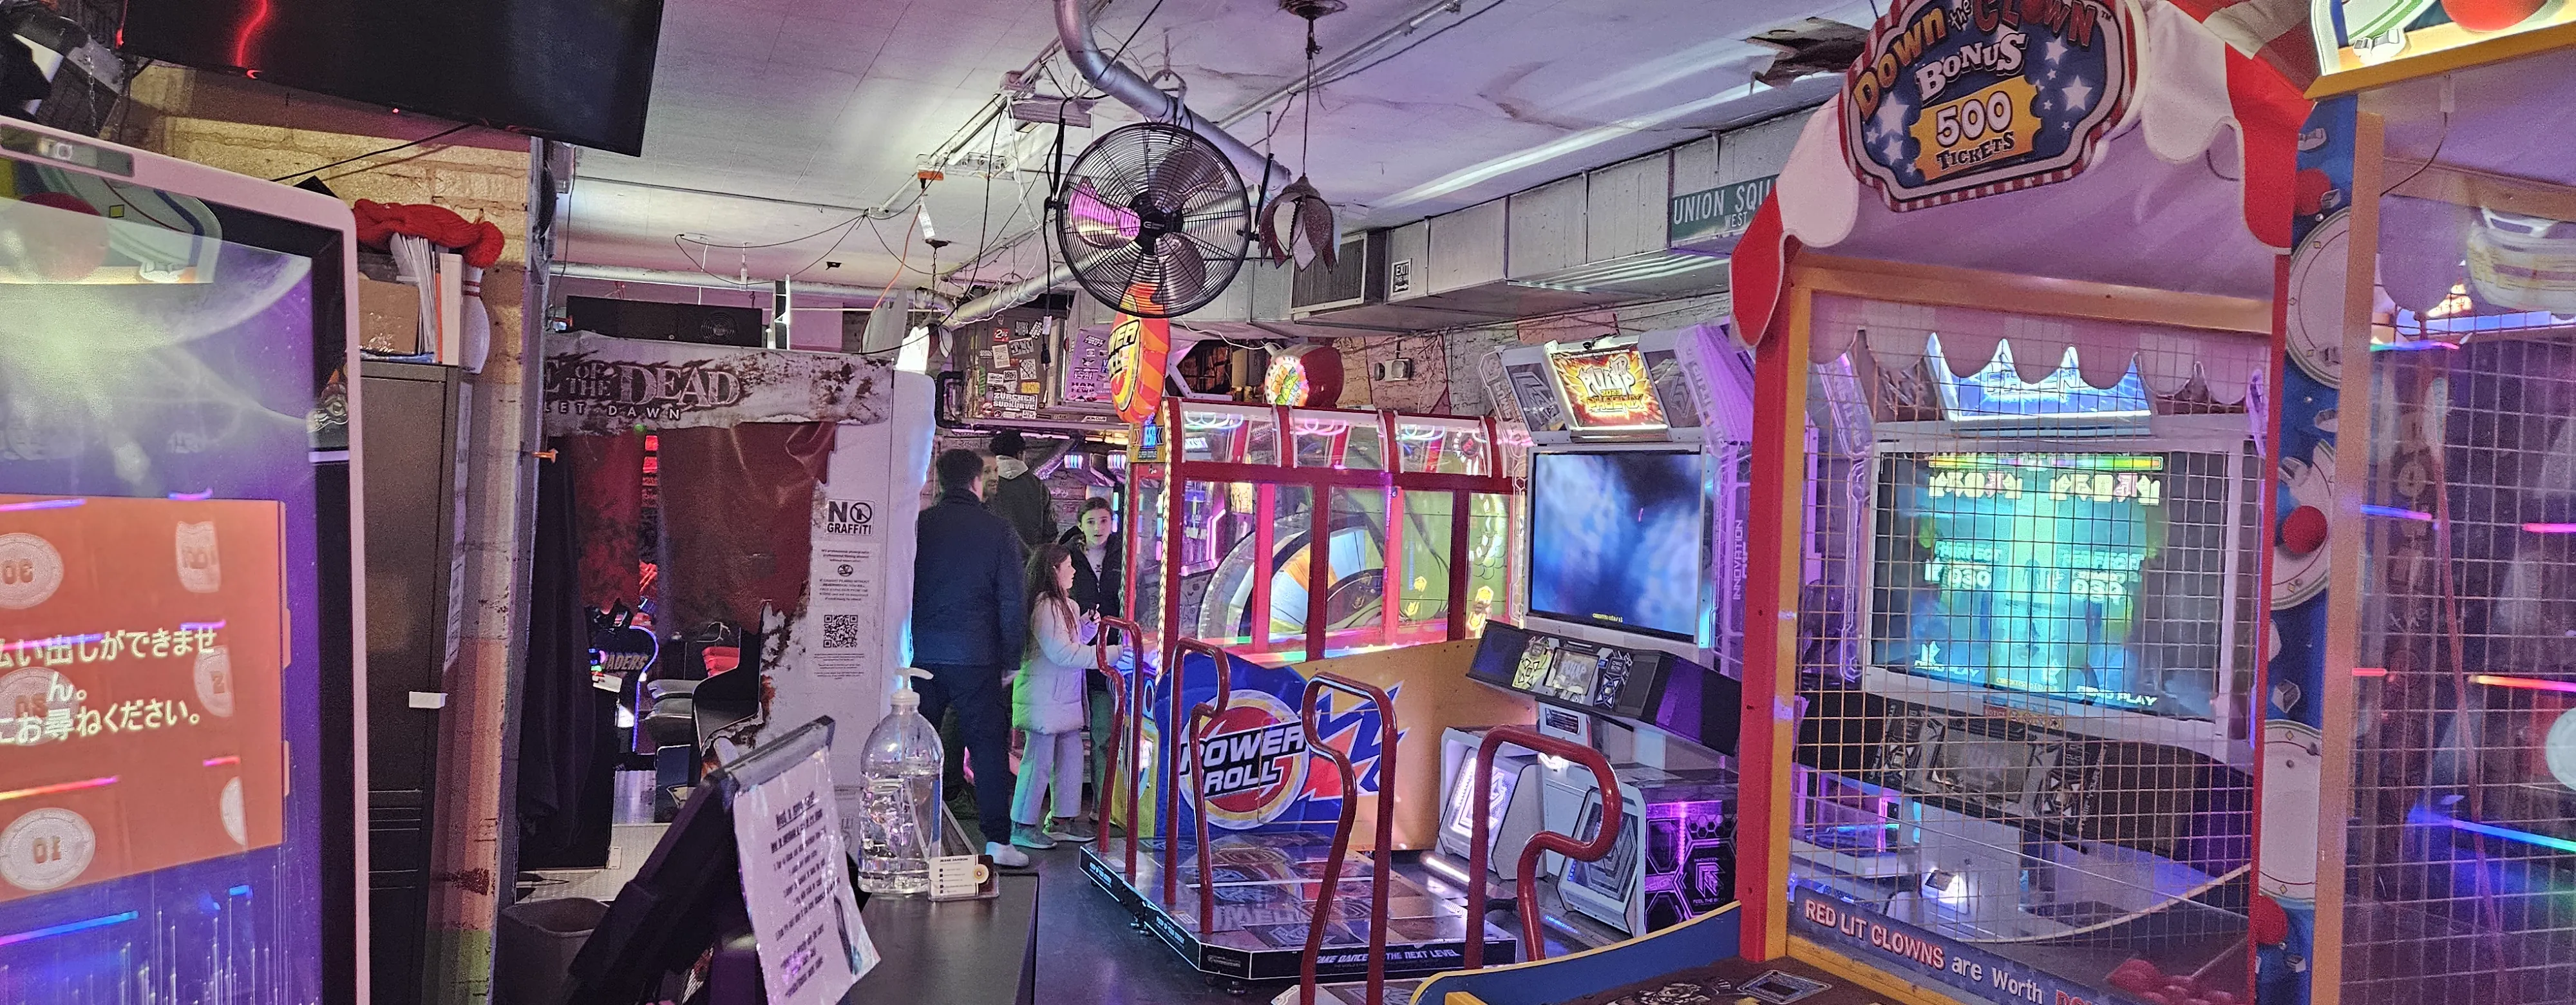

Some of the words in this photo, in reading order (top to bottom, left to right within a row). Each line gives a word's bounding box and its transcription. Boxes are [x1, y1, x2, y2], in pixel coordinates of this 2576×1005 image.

[1949, 0, 1973, 30] the
[1936, 91, 2013, 148] 500
[1936, 131, 2015, 170] TICKETS
[1674, 189, 1724, 225] UNION
[1725, 212, 1747, 227] WEST
[1396, 263, 1408, 276] EXIT
[566, 378, 611, 396] THE
[616, 365, 740, 407] DEAD
[608, 405, 681, 419] DAWN
[1587, 394, 1643, 412] PHOENIX
[827, 523, 871, 535] GRAFFITI
[1732, 519, 1743, 600] INNOVATION
[2117, 693, 2157, 706] PLAY
[1204, 761, 1278, 794] ROLL
[1337, 953, 1368, 963] DANCE
[1429, 948, 1461, 958] LEVEL
[1805, 899, 1837, 928] RED
[1841, 913, 1867, 939] LIT
[1871, 924, 1945, 970] CLOWNS
[1951, 955, 1983, 981] are
[1992, 967, 2043, 1005] Worth
